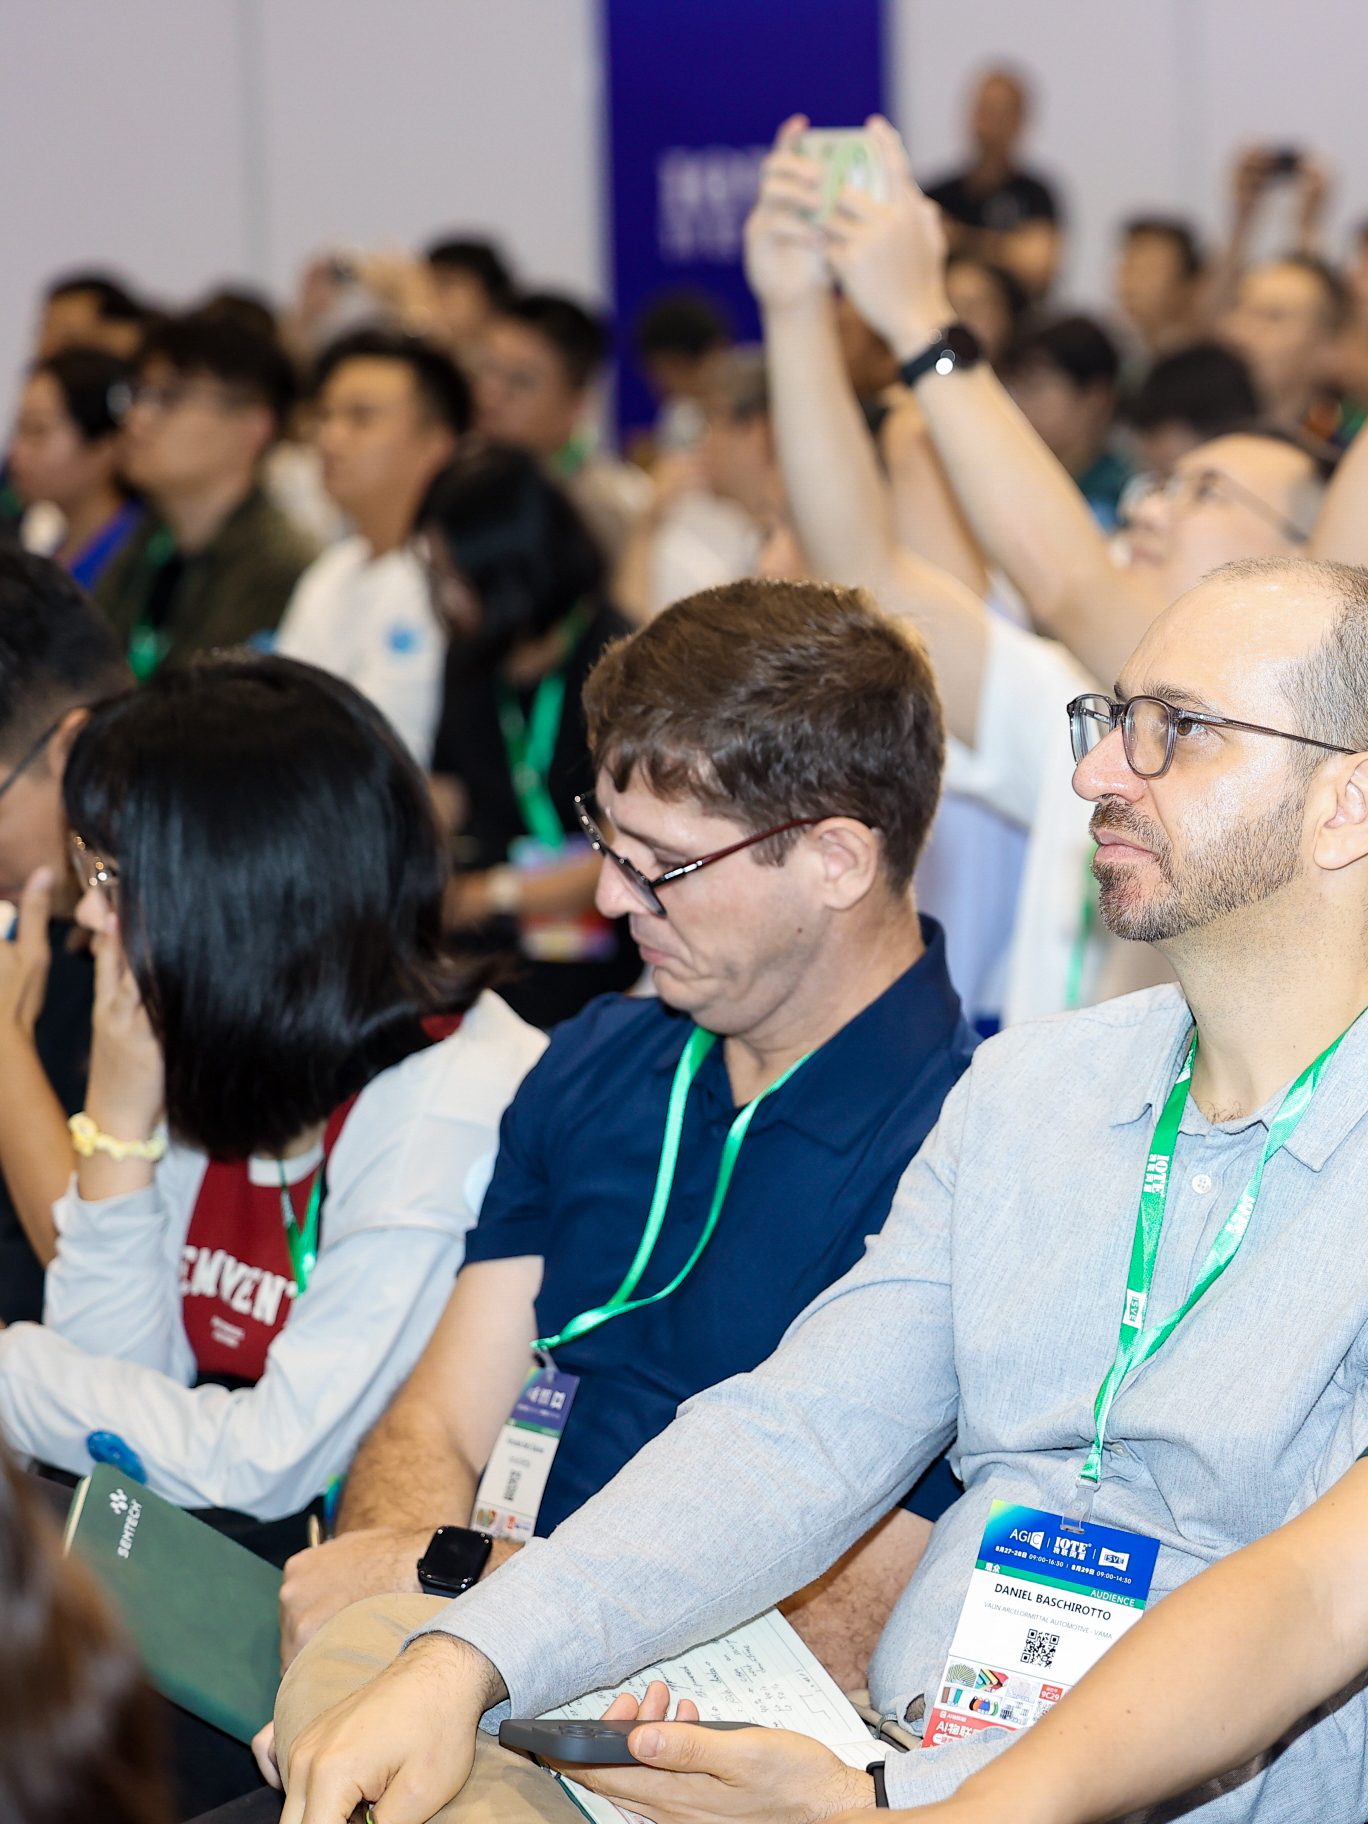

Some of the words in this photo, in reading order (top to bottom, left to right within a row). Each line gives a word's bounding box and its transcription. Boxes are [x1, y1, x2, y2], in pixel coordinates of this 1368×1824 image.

[117, 1498, 142, 1559] SEMTECH
[1009, 1528, 1045, 1550] AGIC
[1054, 1536, 1088, 1552] IOTE
[1028, 1552, 1064, 1568] 09:00-16:30
[1096, 1570, 1132, 1585] 09:00-14:30
[994, 1583, 1032, 1601] DANIEL
[1036, 1594, 1111, 1621] BASCHIROTTO
[1090, 1589, 1136, 1607] AUDIENCE
[1002, 1607, 1050, 1623] ARCELORMITTAL
[1050, 1617, 1090, 1634] AUTOMOTIVE
[1094, 1629, 1113, 1639] VAMA
[936, 1720, 976, 1738] AI物联
